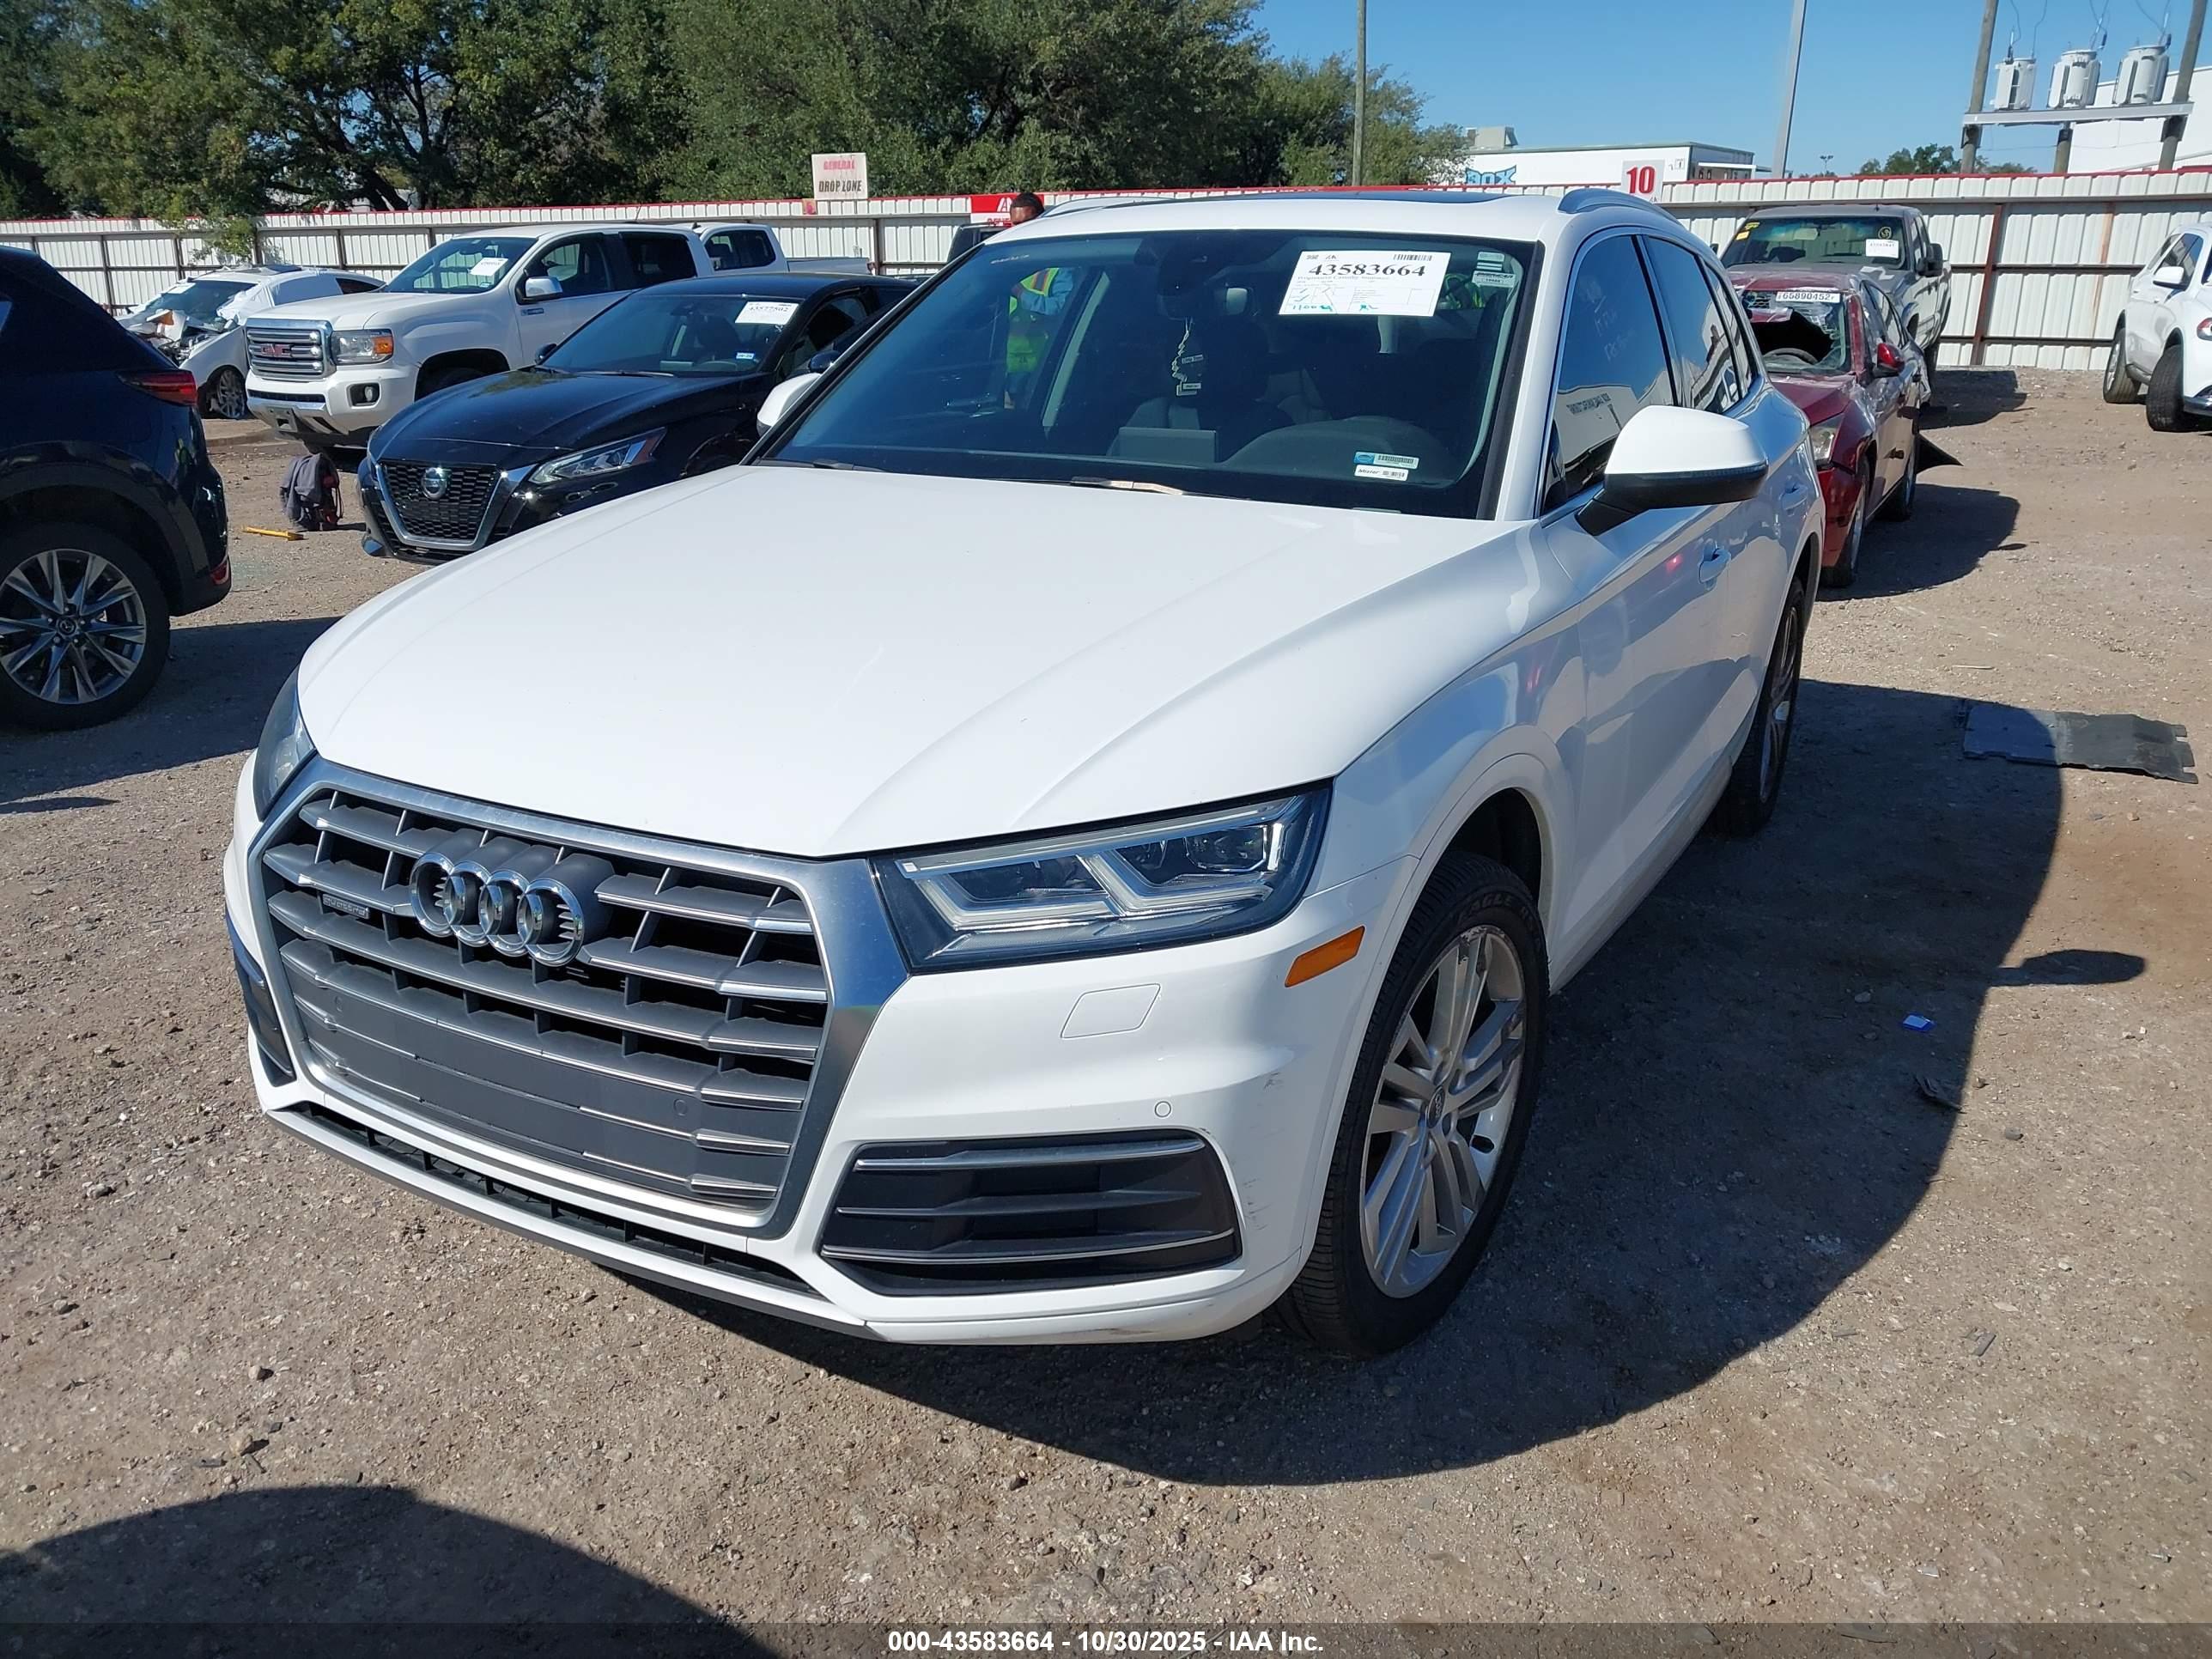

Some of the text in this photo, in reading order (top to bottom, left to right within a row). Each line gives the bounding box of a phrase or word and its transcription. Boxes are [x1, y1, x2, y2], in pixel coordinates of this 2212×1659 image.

[818, 179, 862, 192] DROP ZONE
[1626, 166, 1656, 194] 10
[1309, 263, 1425, 276] 43583664
[260, 343, 291, 358] GMC
